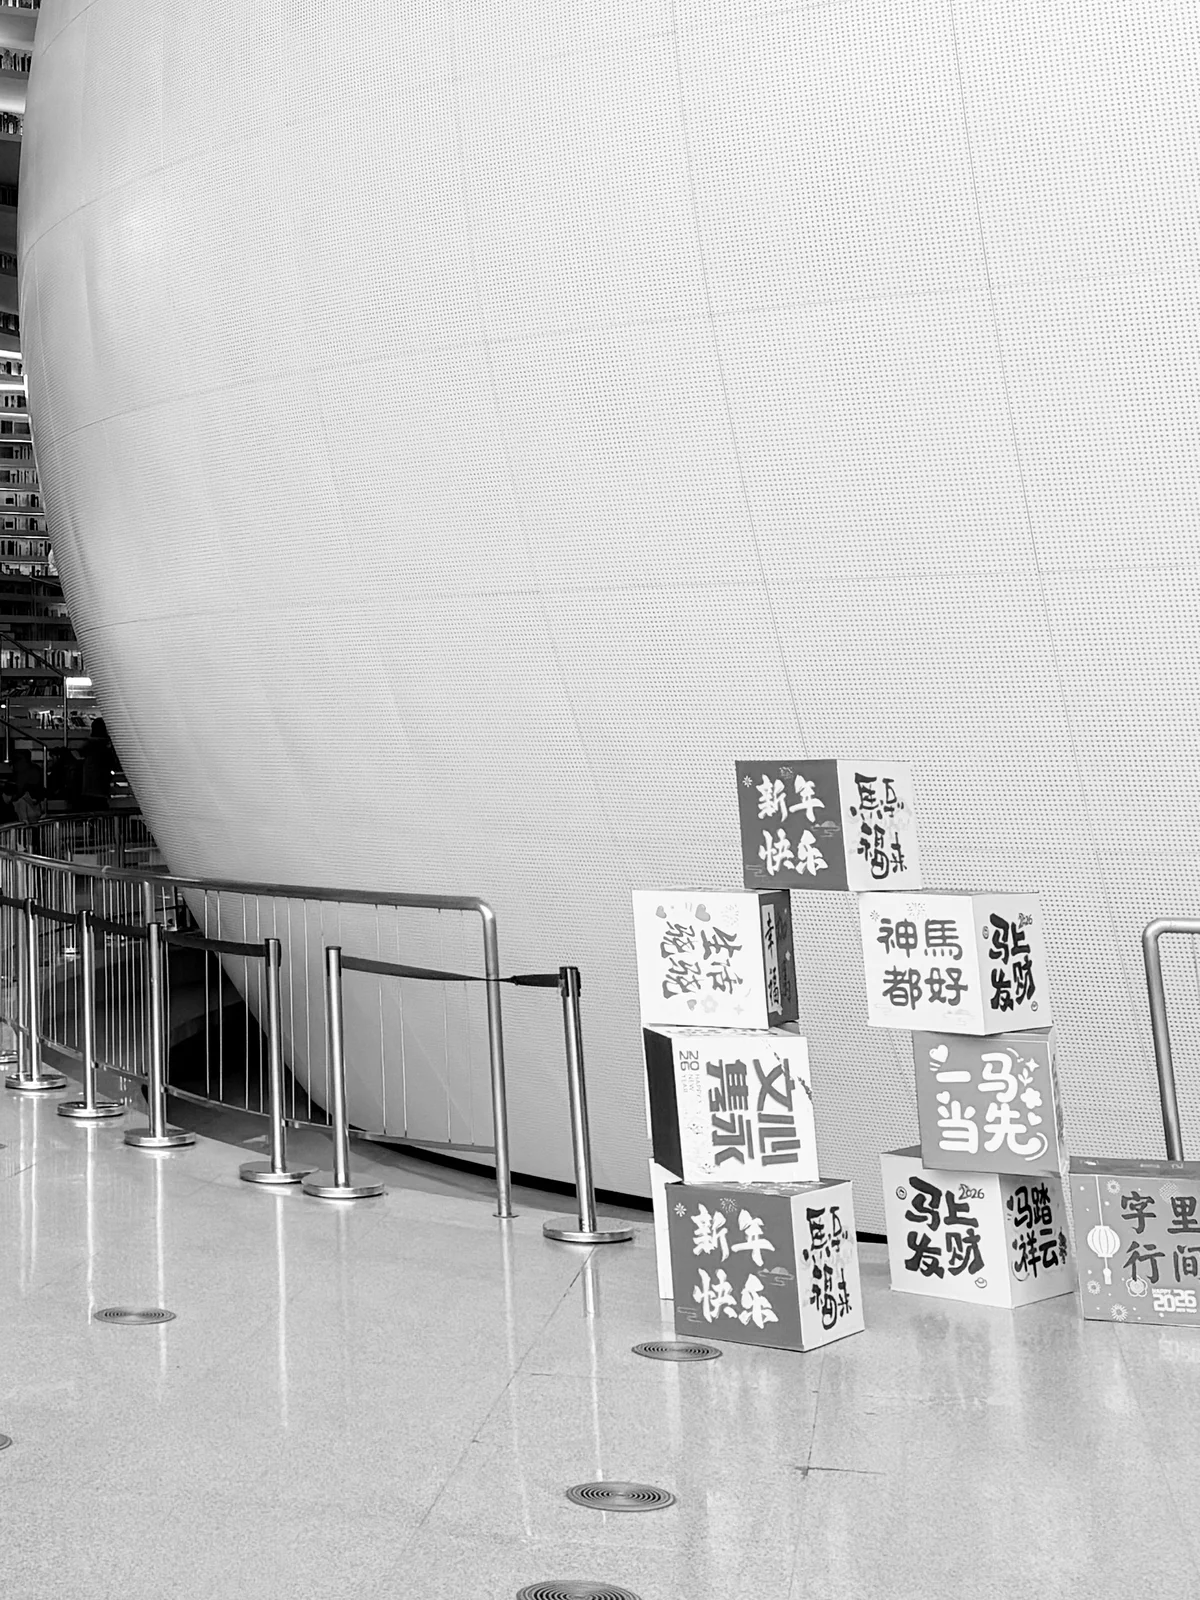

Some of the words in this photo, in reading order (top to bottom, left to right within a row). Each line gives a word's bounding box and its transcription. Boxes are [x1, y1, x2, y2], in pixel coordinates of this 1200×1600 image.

[755, 774, 825, 822] 新年
[758, 828, 828, 876] 快乐
[700, 926, 743, 995] 生活
[876, 918, 963, 961] 神馬
[989, 913, 1031, 965] 马上
[882, 965, 968, 1010] 都好
[991, 954, 1036, 1012] 发财
[936, 1053, 1018, 1103] 一马
[753, 1058, 801, 1167] 文心
[937, 1100, 1042, 1155] 当先
[905, 1176, 979, 1231] 马上
[959, 1184, 985, 1200] 2026
[1014, 1182, 1053, 1228] 马踏
[1121, 1191, 1200, 1234] 字里
[691, 1203, 776, 1267] 新年
[905, 1228, 984, 1279] 发财
[1014, 1228, 1059, 1278] 祥云
[1123, 1241, 1200, 1284] 行间
[692, 1267, 779, 1329] 快乐
[1153, 1289, 1197, 1311] 2026
